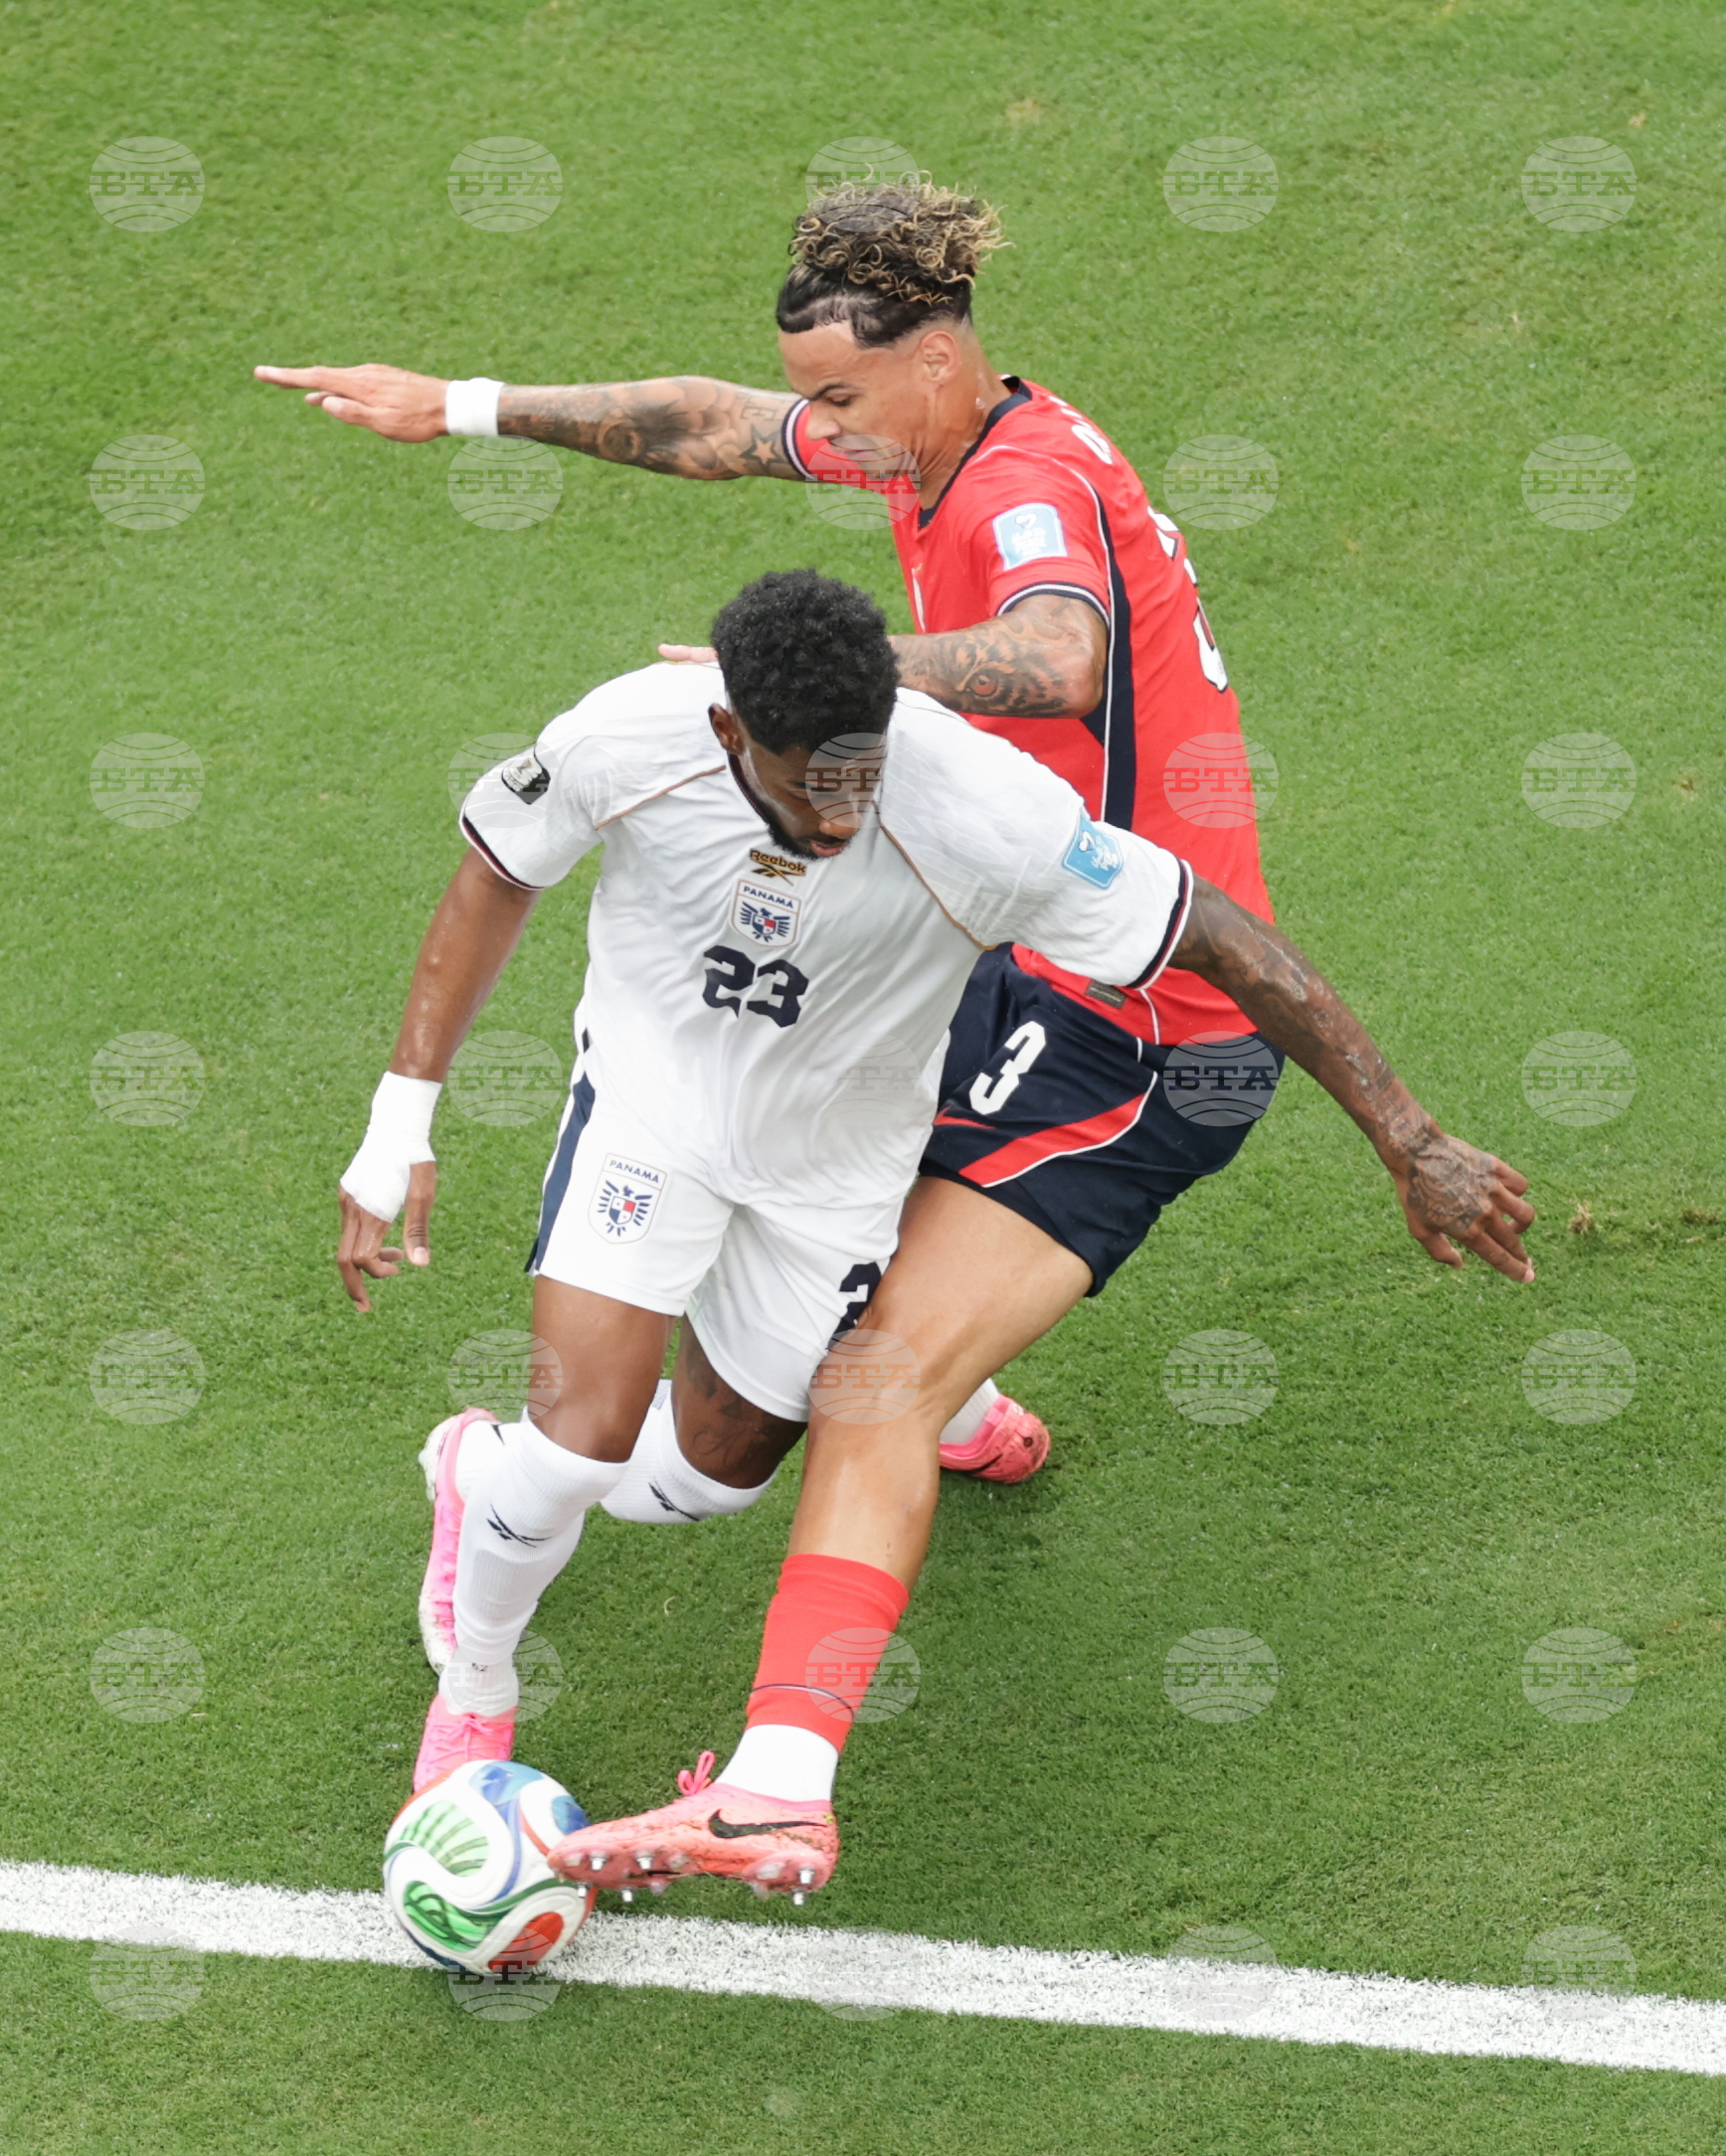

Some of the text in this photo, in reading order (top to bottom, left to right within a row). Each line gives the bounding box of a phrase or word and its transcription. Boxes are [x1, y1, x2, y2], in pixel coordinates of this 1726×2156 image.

[750, 849, 806, 874] Reebok
[702, 945, 809, 1028] 23
[968, 1021, 1046, 1115] 3
